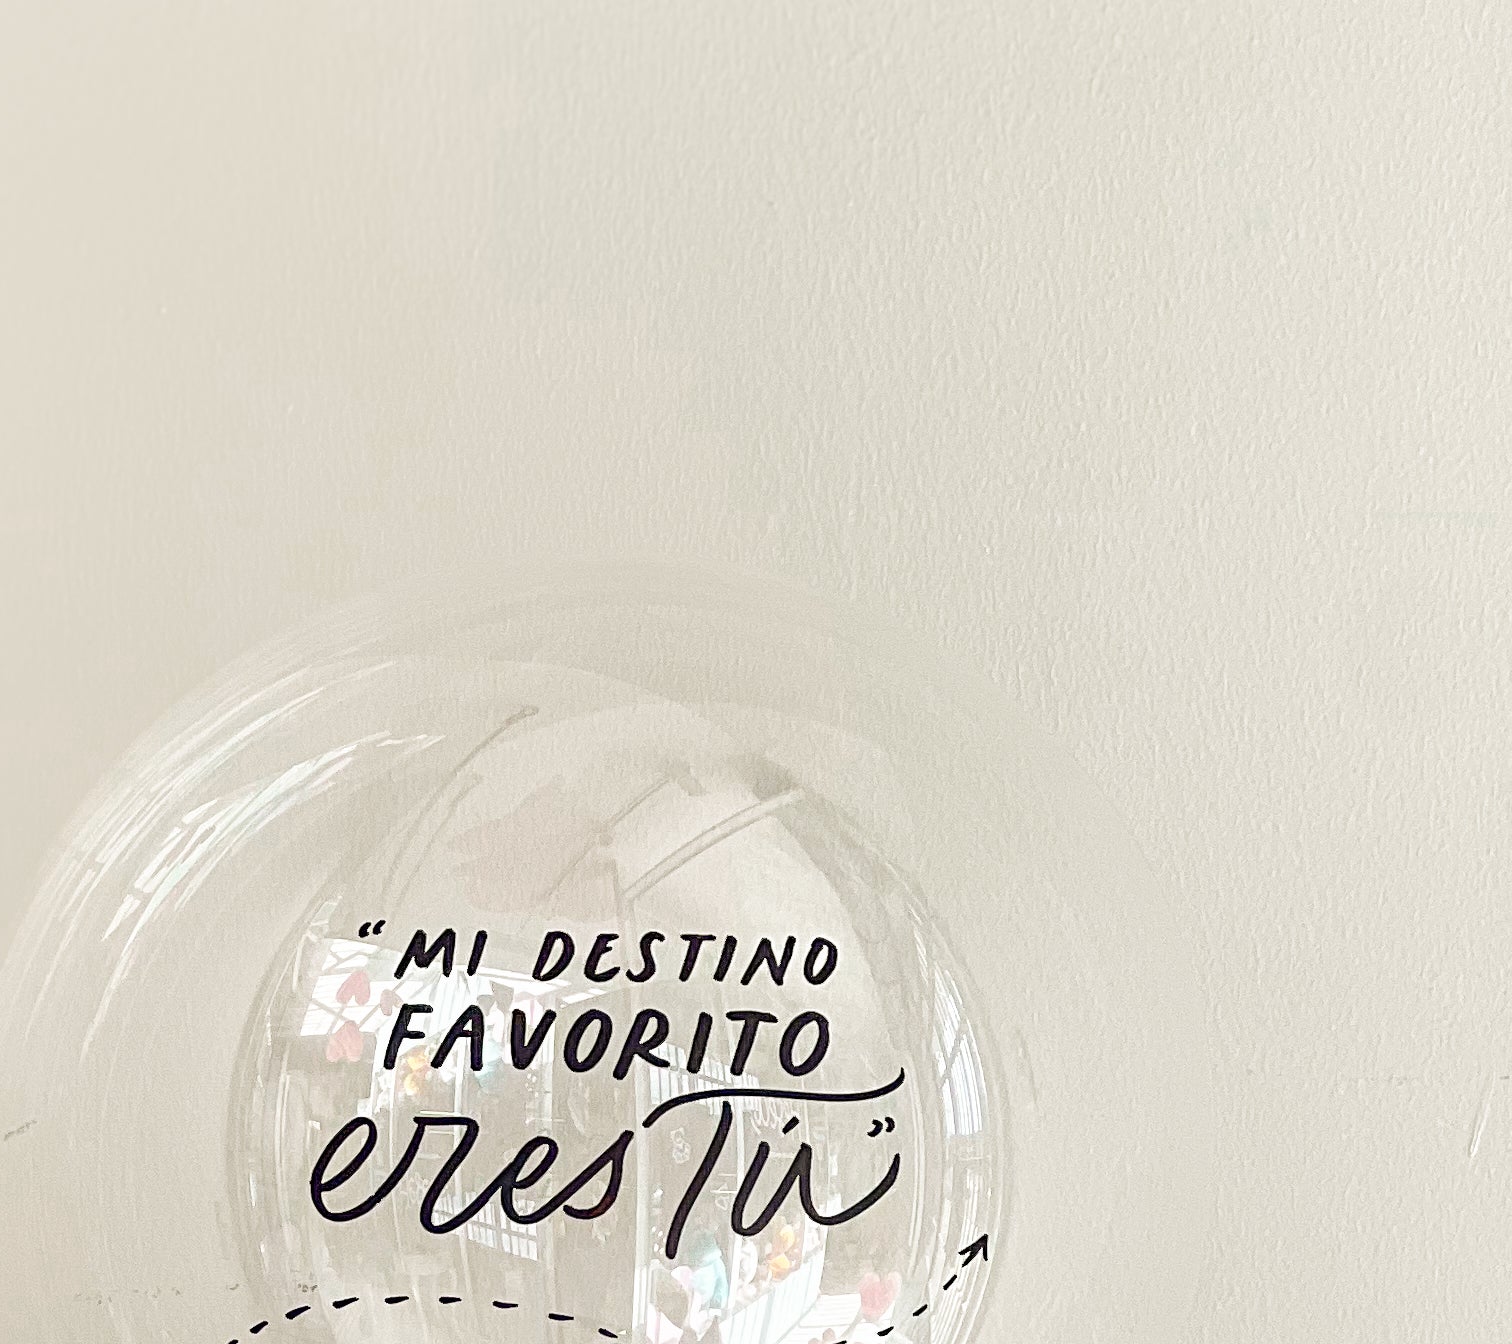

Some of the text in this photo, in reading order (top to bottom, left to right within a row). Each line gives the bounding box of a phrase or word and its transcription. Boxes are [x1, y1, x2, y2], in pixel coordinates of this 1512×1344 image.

[533, 931, 839, 985] DESTINO
[383, 1002, 829, 1080] FAVORITO
[310, 1116, 634, 1234] eres
